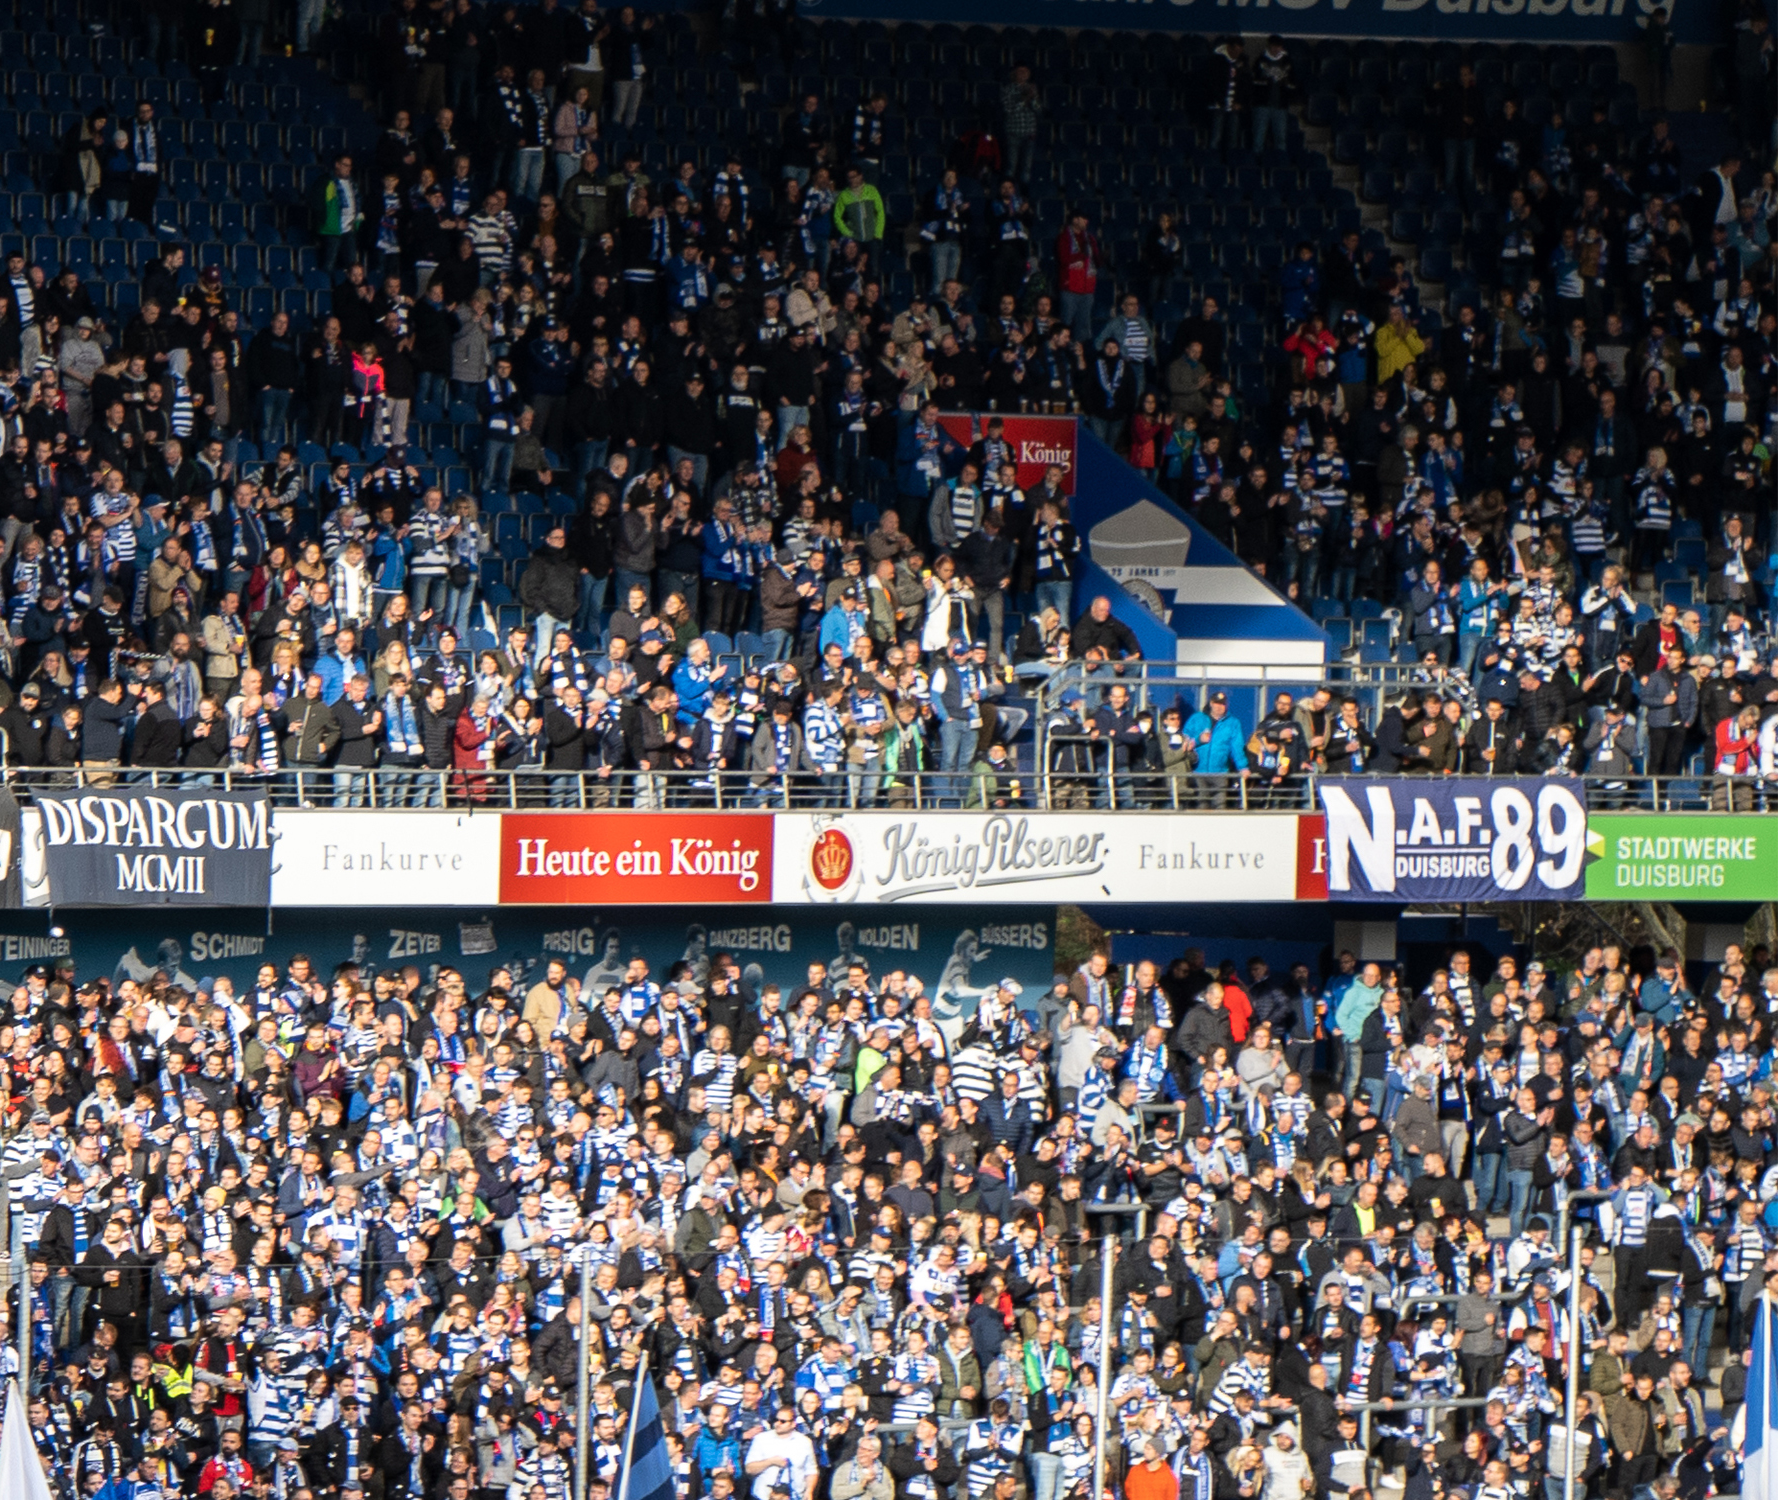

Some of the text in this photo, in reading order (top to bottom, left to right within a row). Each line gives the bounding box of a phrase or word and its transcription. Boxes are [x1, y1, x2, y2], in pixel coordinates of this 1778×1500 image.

[1020, 441, 1072, 473] König
[48, 798, 271, 850] DISPARGUM
[1492, 783, 1587, 891] 89
[323, 842, 464, 872] Fankurve
[883, 813, 1106, 887] König Pilsener
[1139, 842, 1266, 872] Fankurve
[1615, 834, 1758, 861] STADTWERKE
[115, 854, 206, 895] MCMII
[517, 838, 761, 891] Heute ein König
[1395, 854, 1492, 881] DUISBURG
[1615, 861, 1726, 888] DUISBURG
[190, 932, 266, 962] SCHMIDT
[388, 929, 442, 959] ZEYER
[544, 927, 595, 955] PIRSIG
[709, 924, 791, 951] DANZBERG
[858, 925, 919, 951] NOLDEN
[981, 922, 1047, 948] BÜSSERS
